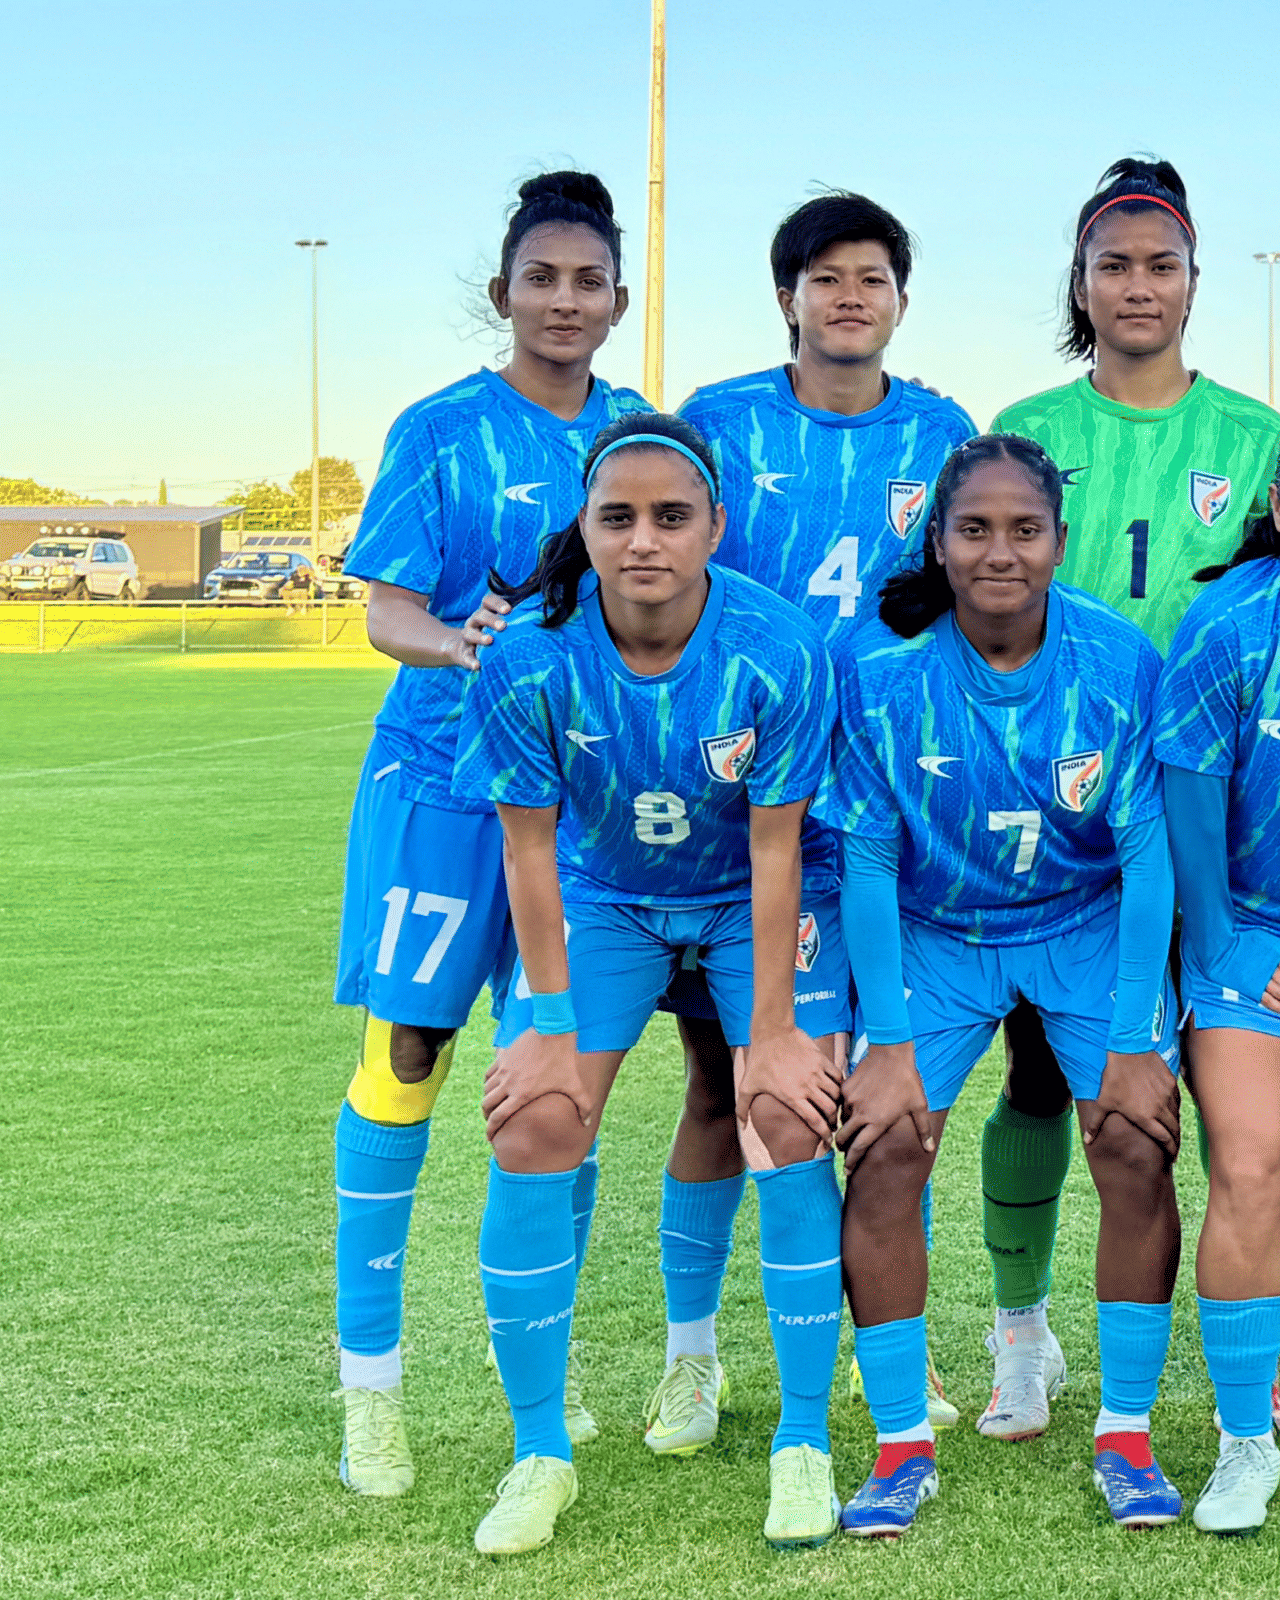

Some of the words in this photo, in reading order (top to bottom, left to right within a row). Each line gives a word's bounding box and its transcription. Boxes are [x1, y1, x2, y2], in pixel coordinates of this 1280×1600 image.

[1196, 477, 1217, 487] INDIA
[808, 536, 863, 618] 4
[1125, 520, 1149, 599] 1
[710, 738, 738, 751] INDIA
[1061, 760, 1086, 771] INDIA
[634, 791, 690, 844] 8
[988, 810, 1042, 874] 7
[375, 886, 469, 984] 17
